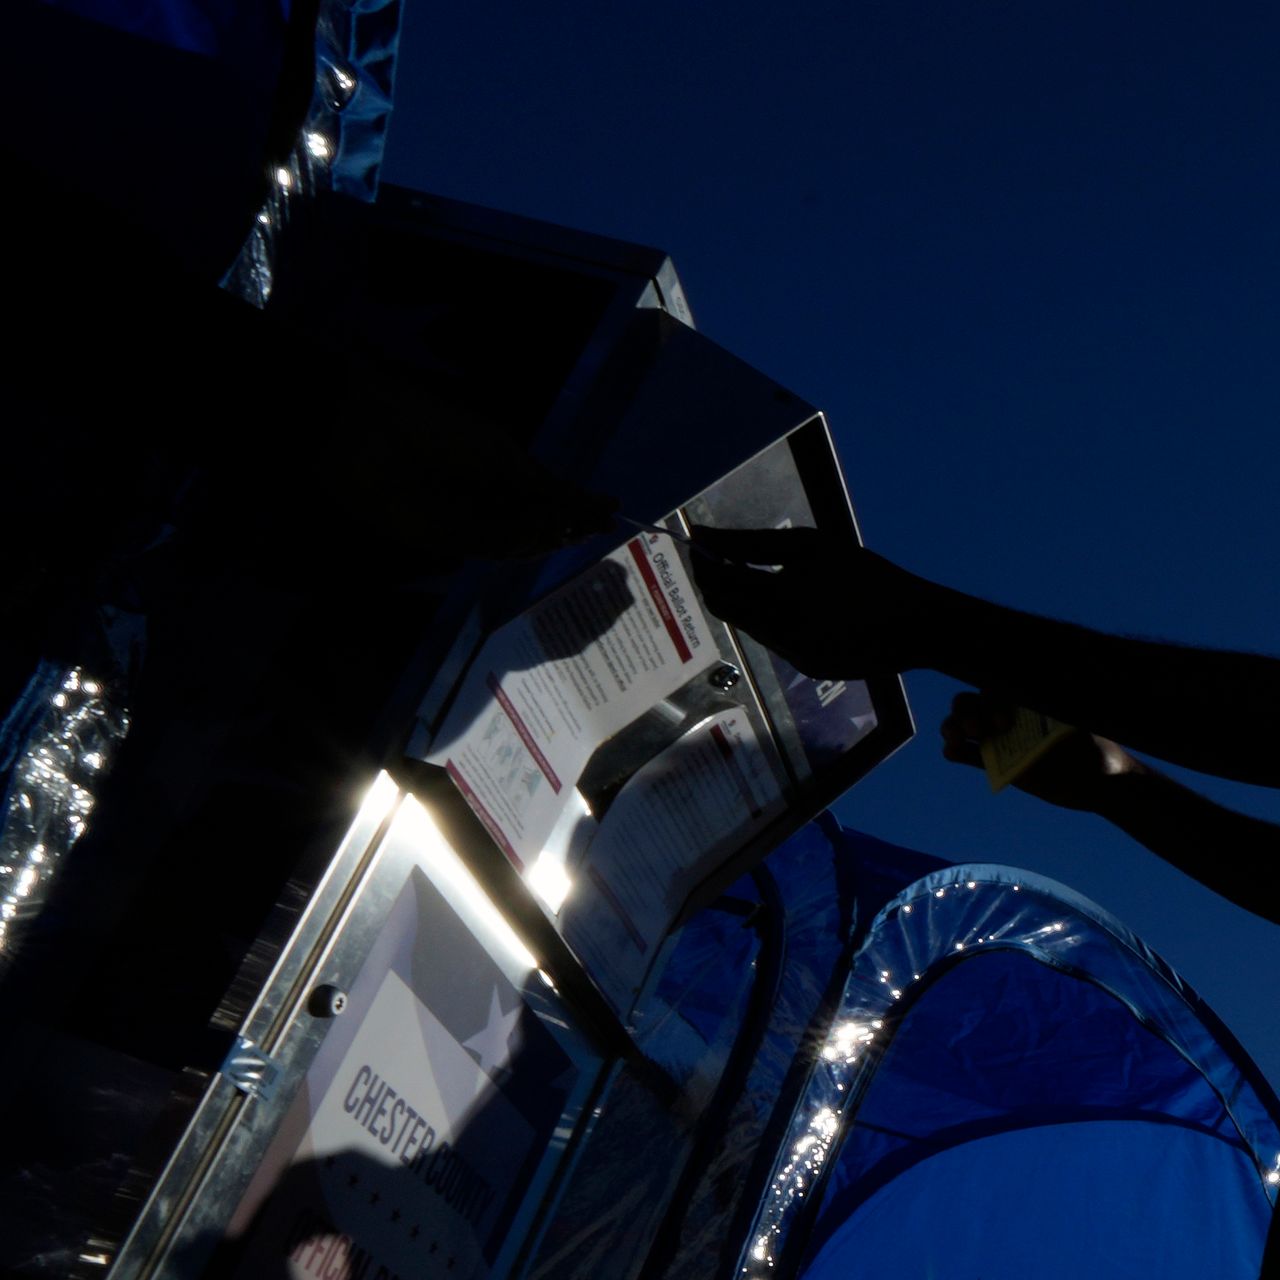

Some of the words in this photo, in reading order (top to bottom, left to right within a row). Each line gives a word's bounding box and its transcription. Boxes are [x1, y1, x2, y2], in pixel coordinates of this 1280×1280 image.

[652, 551, 676, 590] Official
[668, 586, 688, 619] Ballot
[682, 615, 701, 649] Return
[343, 1064, 436, 1174] CHESTER
[425, 1141, 496, 1228] COUNTY
